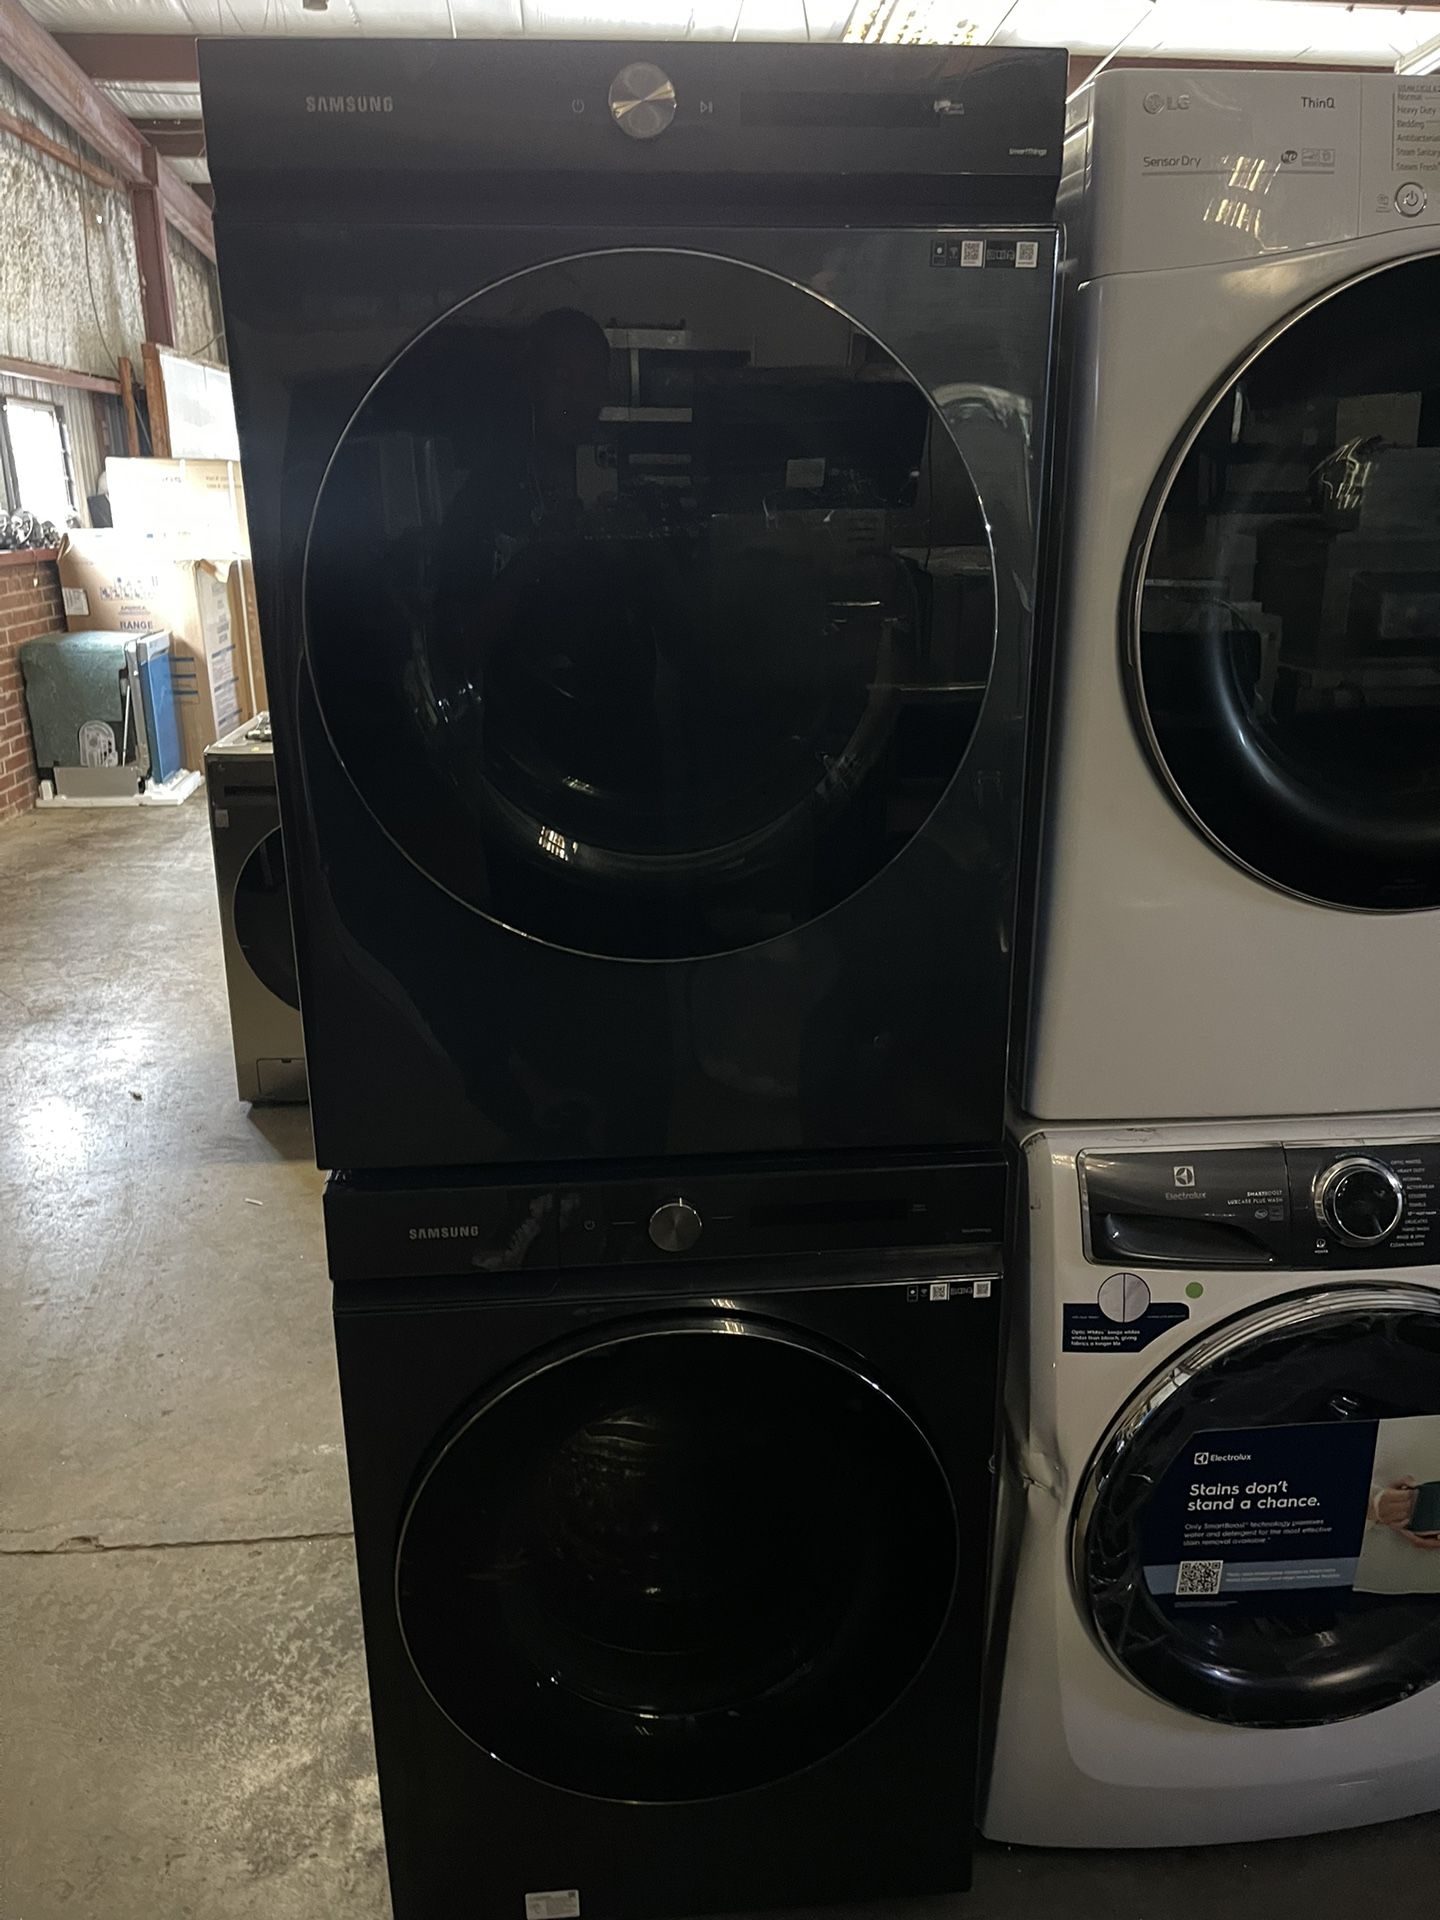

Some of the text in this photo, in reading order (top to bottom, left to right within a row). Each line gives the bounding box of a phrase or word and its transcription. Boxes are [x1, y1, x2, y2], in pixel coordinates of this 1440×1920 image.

[305, 95, 394, 113] SAMSUNG
[1167, 94, 1191, 111] LG
[1300, 96, 1336, 109] ThinQ
[1397, 105, 1437, 117] Heavy Duty
[1397, 119, 1425, 130] Bedding
[1143, 155, 1202, 168] Sensor Dry
[119, 620, 153, 630] RANGE
[1165, 1191, 1207, 1201] Electrolux
[408, 1225, 479, 1240] SAMSUNG
[1210, 1453, 1252, 1462] Electrolux
[1189, 1480, 1289, 1496] Stains don't
[1187, 1496, 1321, 1511] stand a chance.
[1184, 1522, 1202, 1531] Only
[1250, 1520, 1291, 1528] technology
[1206, 1530, 1221, 1538] and
[1221, 1529, 1257, 1537] detergent
[1282, 1527, 1301, 1535] most
[1301, 1526, 1333, 1534] effective
[1201, 1538, 1232, 1546] removal
